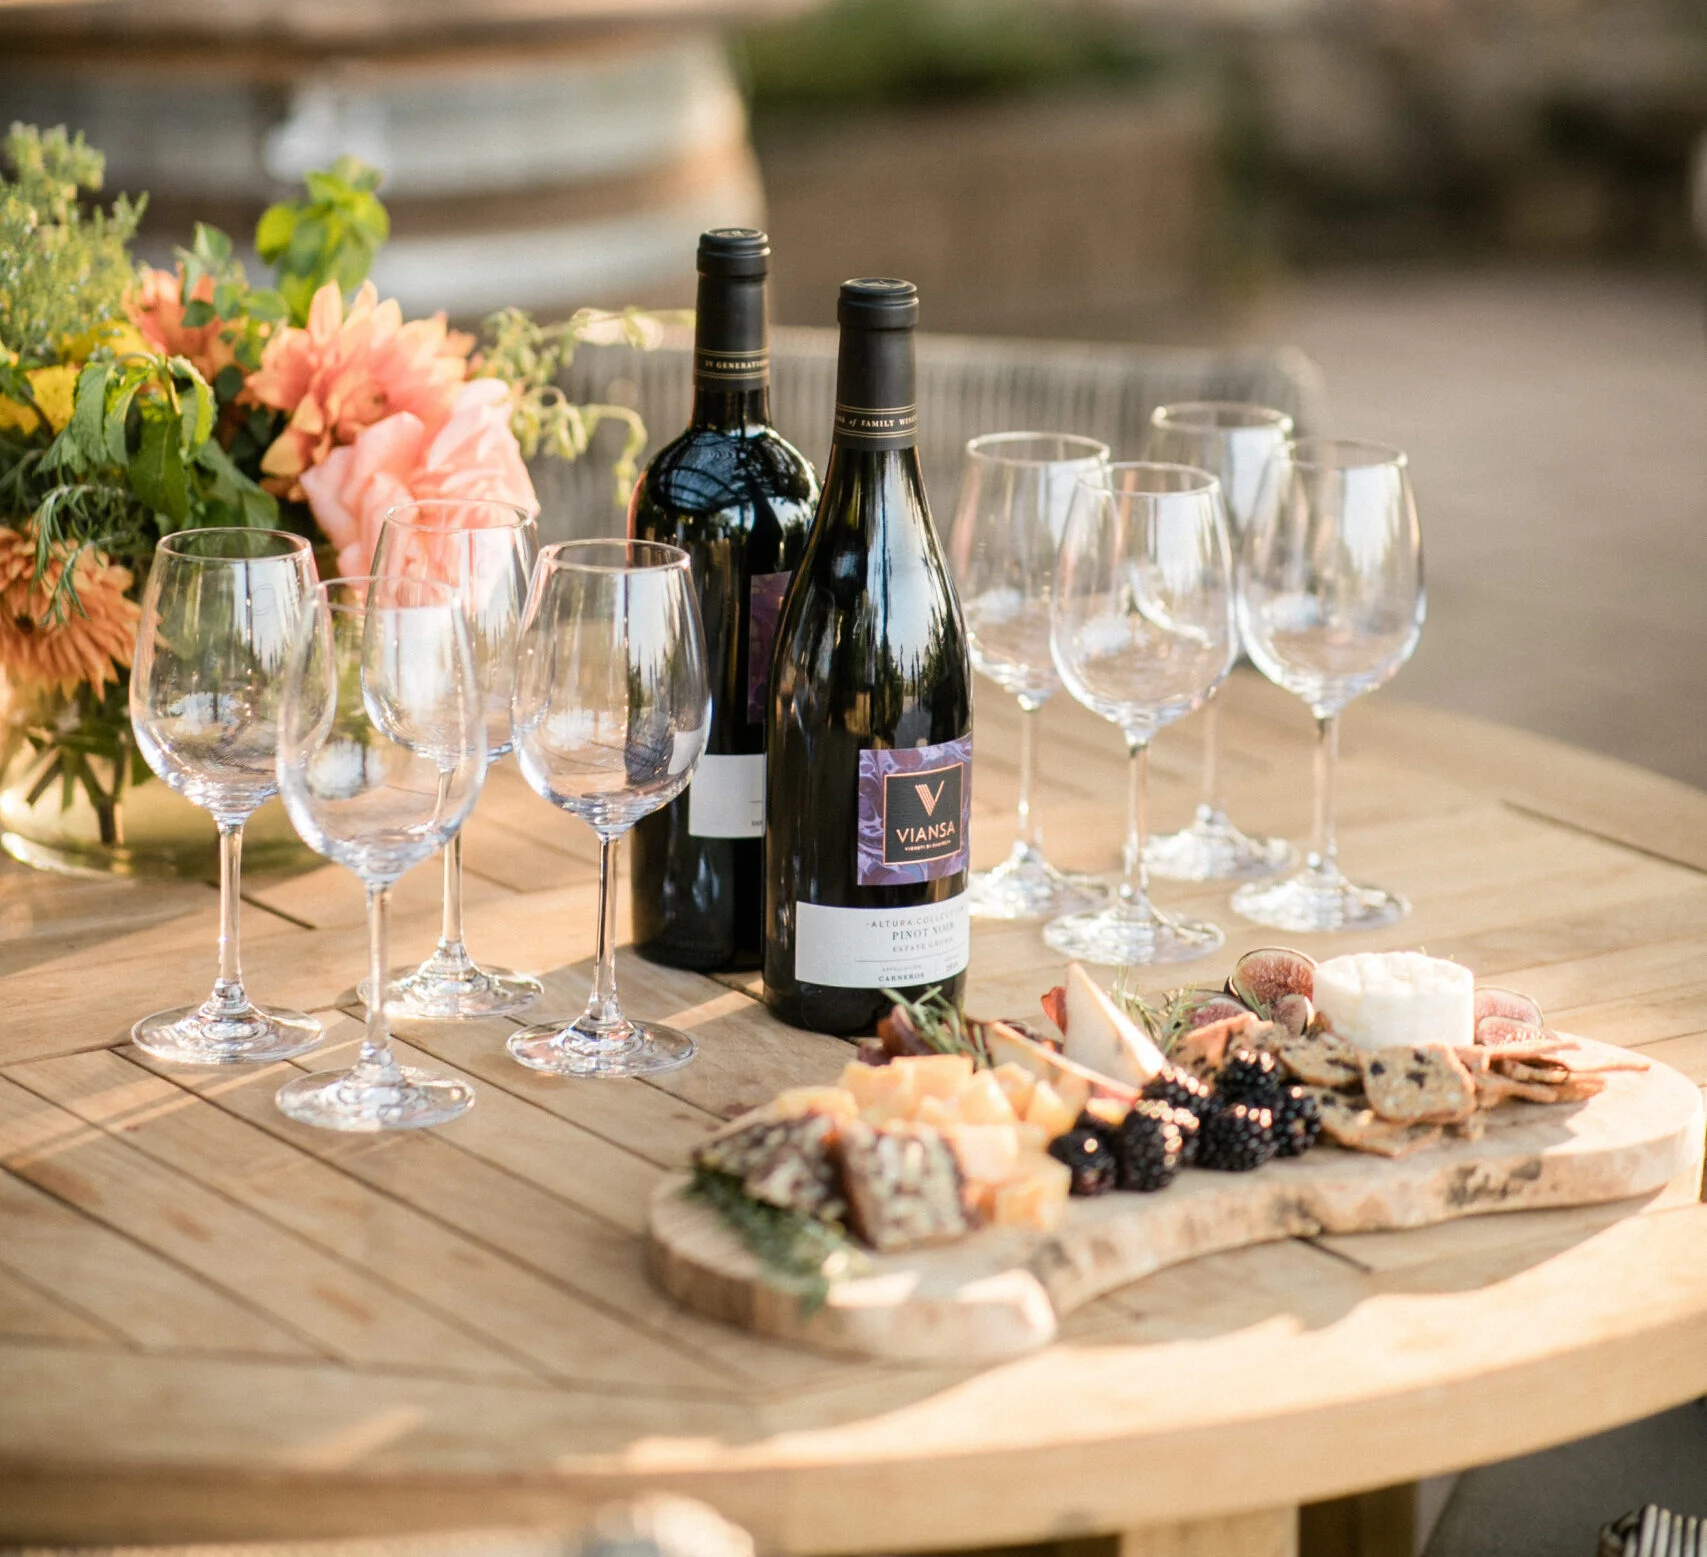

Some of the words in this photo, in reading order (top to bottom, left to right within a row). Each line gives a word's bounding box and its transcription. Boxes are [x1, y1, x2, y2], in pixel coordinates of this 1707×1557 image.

[861, 419, 895, 428] FAMILY
[896, 820, 956, 844] VIANSA
[892, 927, 928, 941] PINOT
[932, 921, 955, 935] NOIR
[892, 943, 926, 953] ESTATE
[878, 973, 925, 983] CARNEROS
